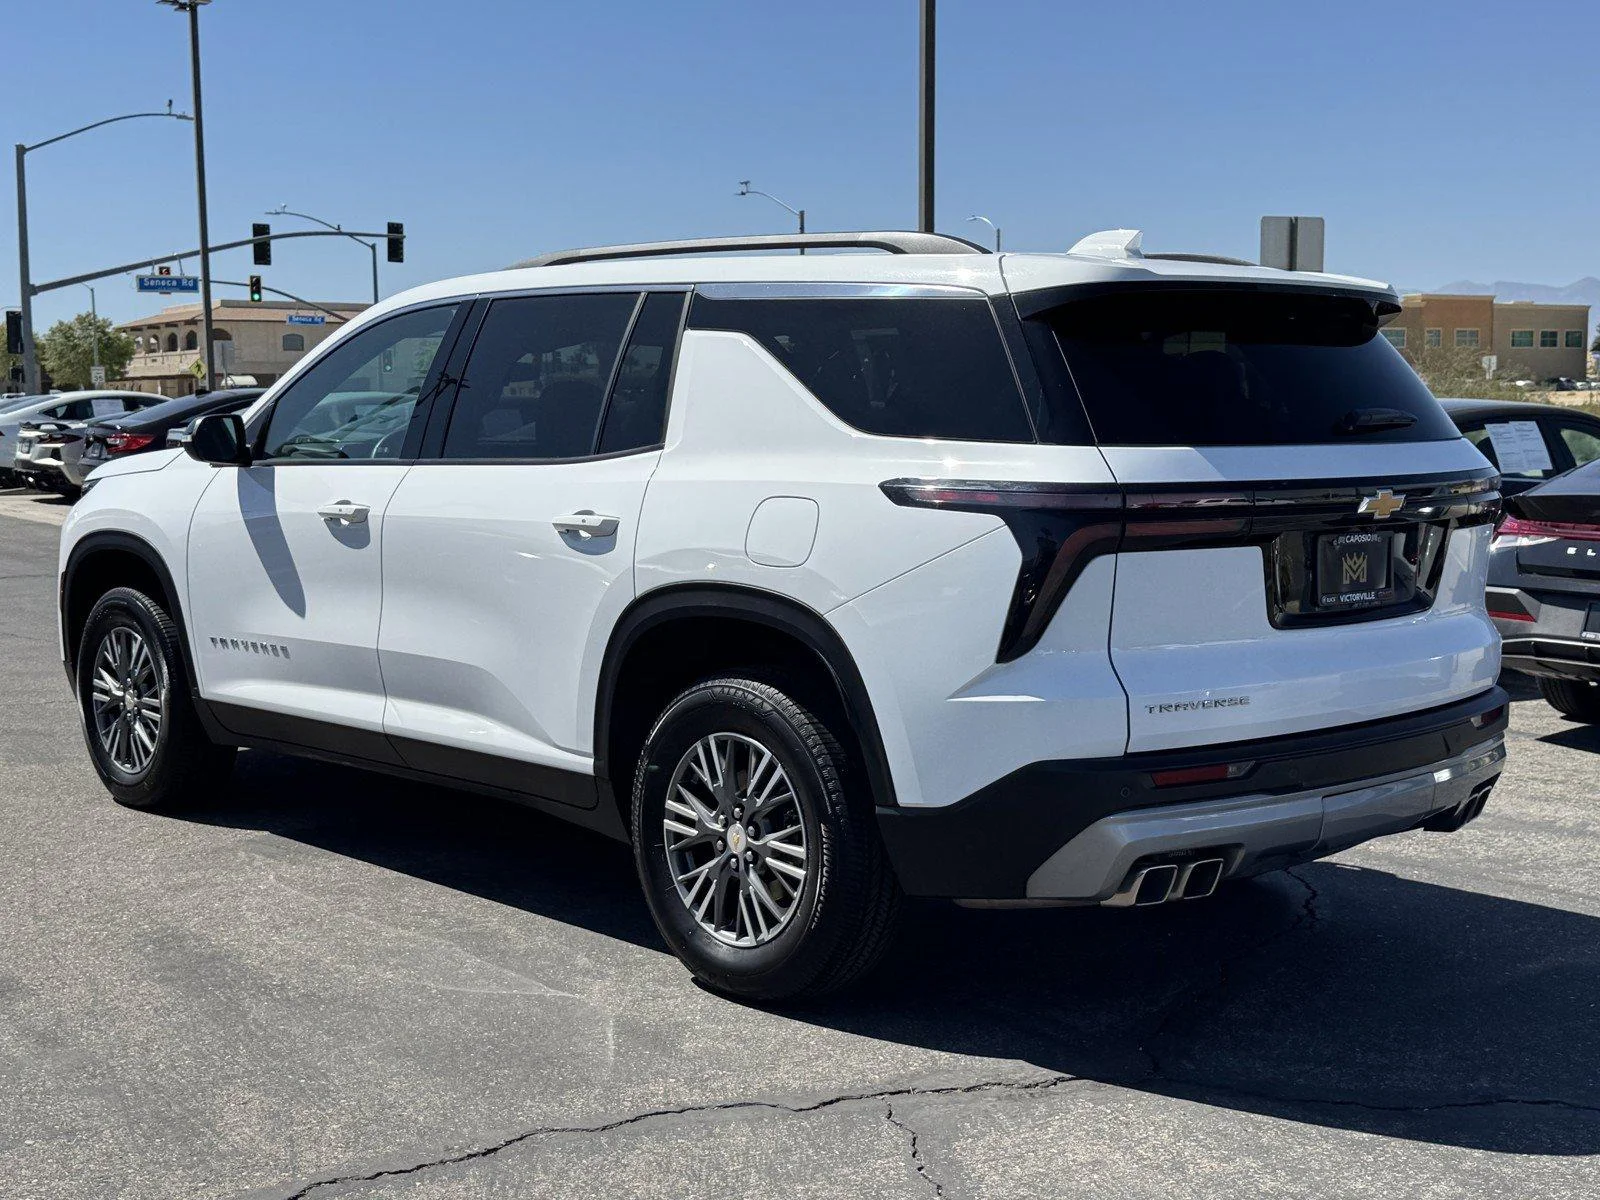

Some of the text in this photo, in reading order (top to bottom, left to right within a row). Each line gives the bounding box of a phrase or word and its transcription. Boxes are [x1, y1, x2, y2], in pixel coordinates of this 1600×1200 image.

[143, 277, 195, 287] Seneca Rd
[1339, 591, 1376, 602] VICTORVILLE
[208, 636, 290, 660] TRAVERSE
[1145, 696, 1250, 714] TRAVERSE
